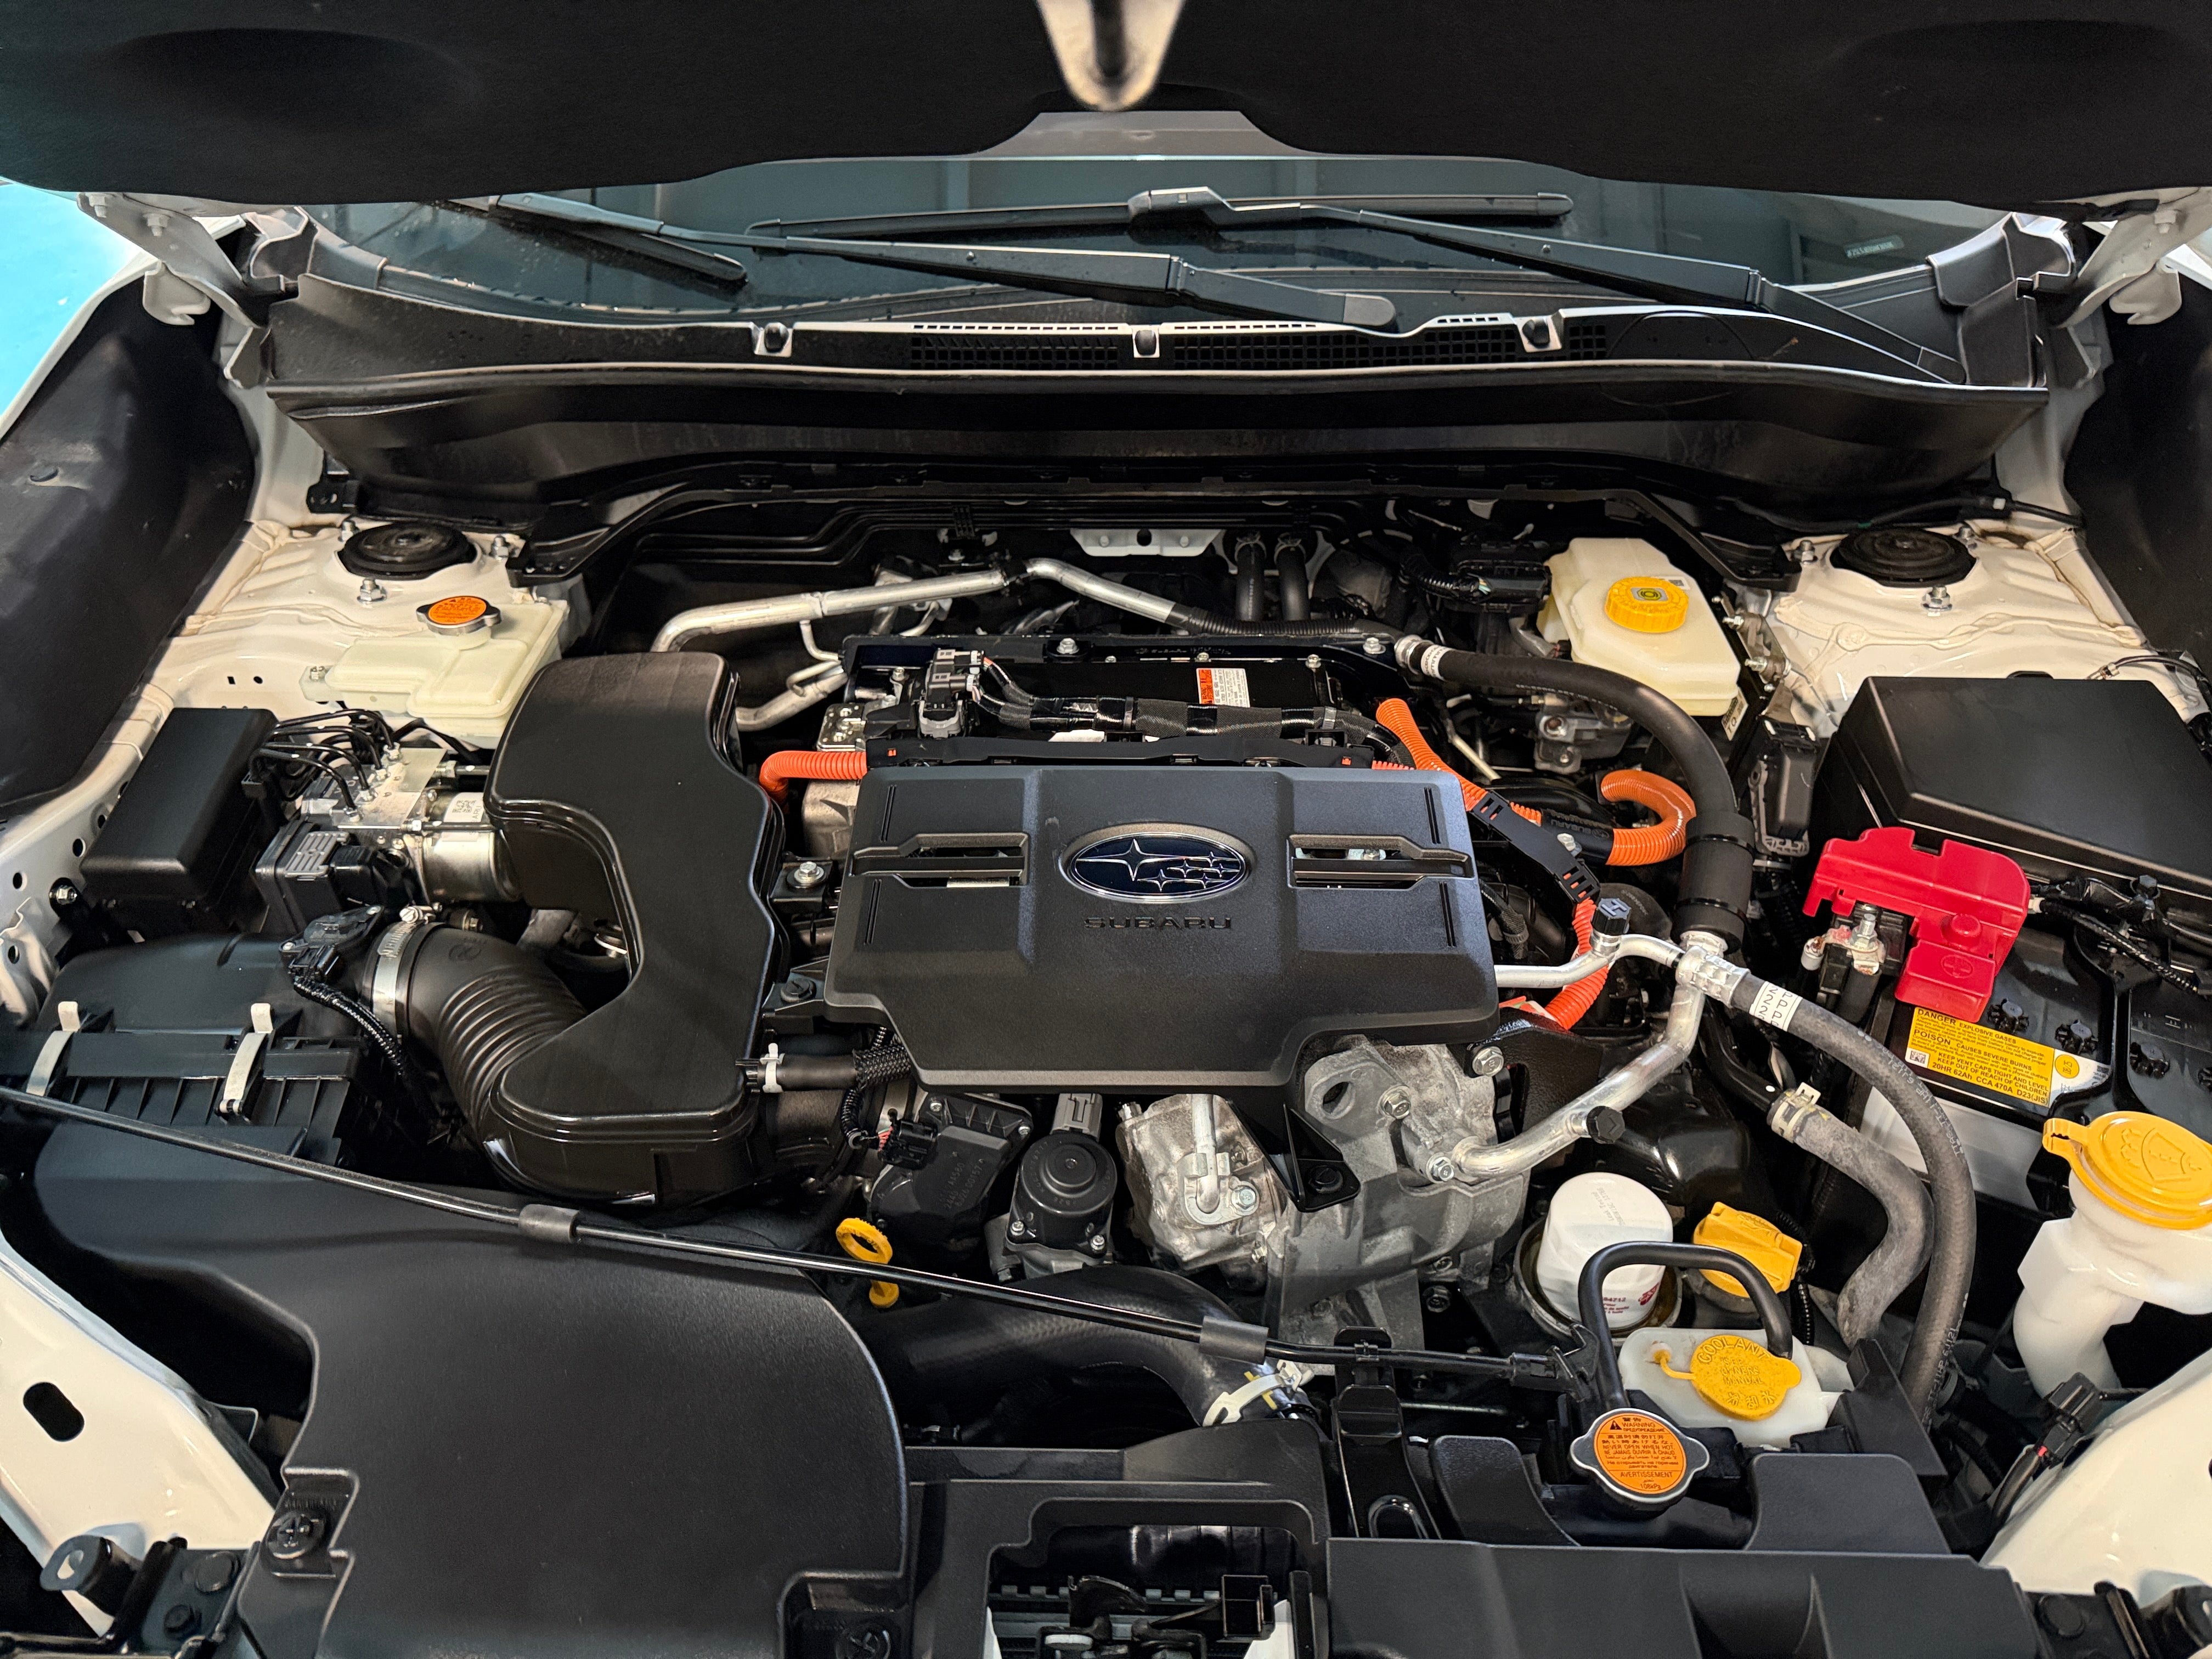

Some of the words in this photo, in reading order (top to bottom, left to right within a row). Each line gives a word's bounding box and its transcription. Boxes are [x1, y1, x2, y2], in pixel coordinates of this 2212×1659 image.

[1551, 820, 1592, 834] SUBARU
[1084, 917, 1231, 929] SUBARU
[1917, 1008, 1956, 1025] DANGER
[1959, 1022, 1993, 1037] EXPLOSIVE
[1994, 1033, 2016, 1044] GASES
[1914, 1029, 1950, 1046] POISON
[1956, 1042, 1982, 1054] CAUSES
[1983, 1051, 2008, 1063] SEVERE
[2010, 1059, 2032, 1070] BURNS
[1932, 1062, 1951, 1073] 20HR
[1953, 1068, 1972, 1080] 62Ah
[1976, 1075, 1993, 1087] CCA
[1994, 1081, 2013, 1093] 470A
[2017, 1088, 2048, 1105] D23(JIS)
[1937, 1057, 1954, 1066] KEEP
[1955, 1063, 1968, 1071] OUT
[1980, 1070, 2002, 1082] REACH
[2015, 1081, 2047, 1097] CHILDREN
[1938, 1052, 1955, 1060] KEEP
[1956, 1057, 1972, 1066] VENT
[1974, 1063, 1991, 1073] CAPS
[1993, 1069, 2012, 1079] TIGHT
[2013, 1075, 2027, 1084] AND
[2028, 1080, 2049, 1091] LEVEL
[1697, 1337, 1770, 1363] COOLANT
[1723, 1375, 1763, 1385] MANUAL
